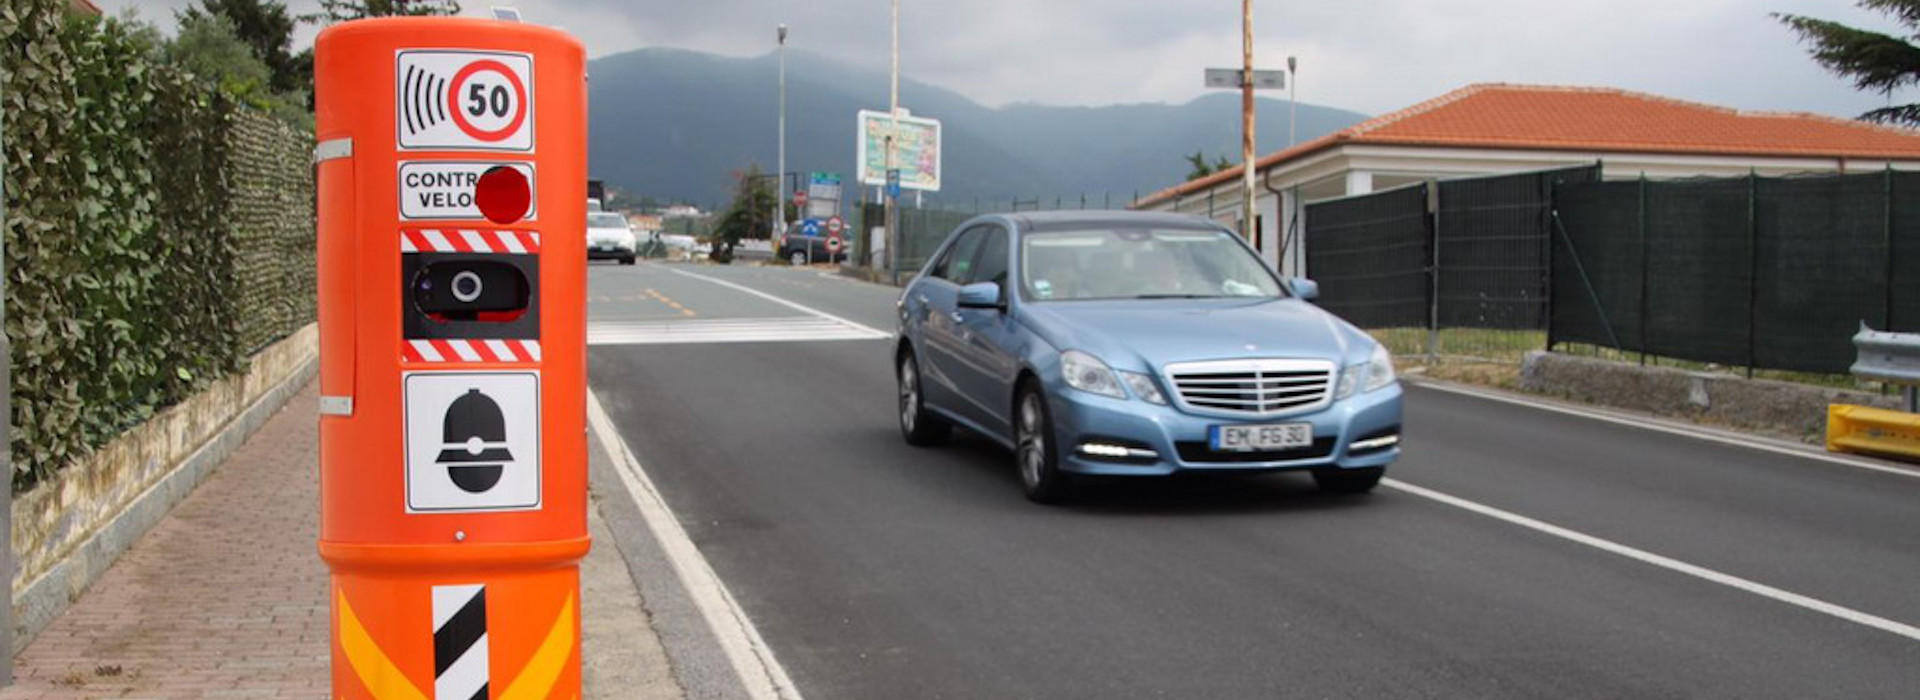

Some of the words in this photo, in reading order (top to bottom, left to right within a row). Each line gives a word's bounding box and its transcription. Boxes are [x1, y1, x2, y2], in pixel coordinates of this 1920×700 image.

[468, 84, 510, 117] 50
[406, 172, 477, 188] CONTR
[419, 192, 475, 207] VELO
